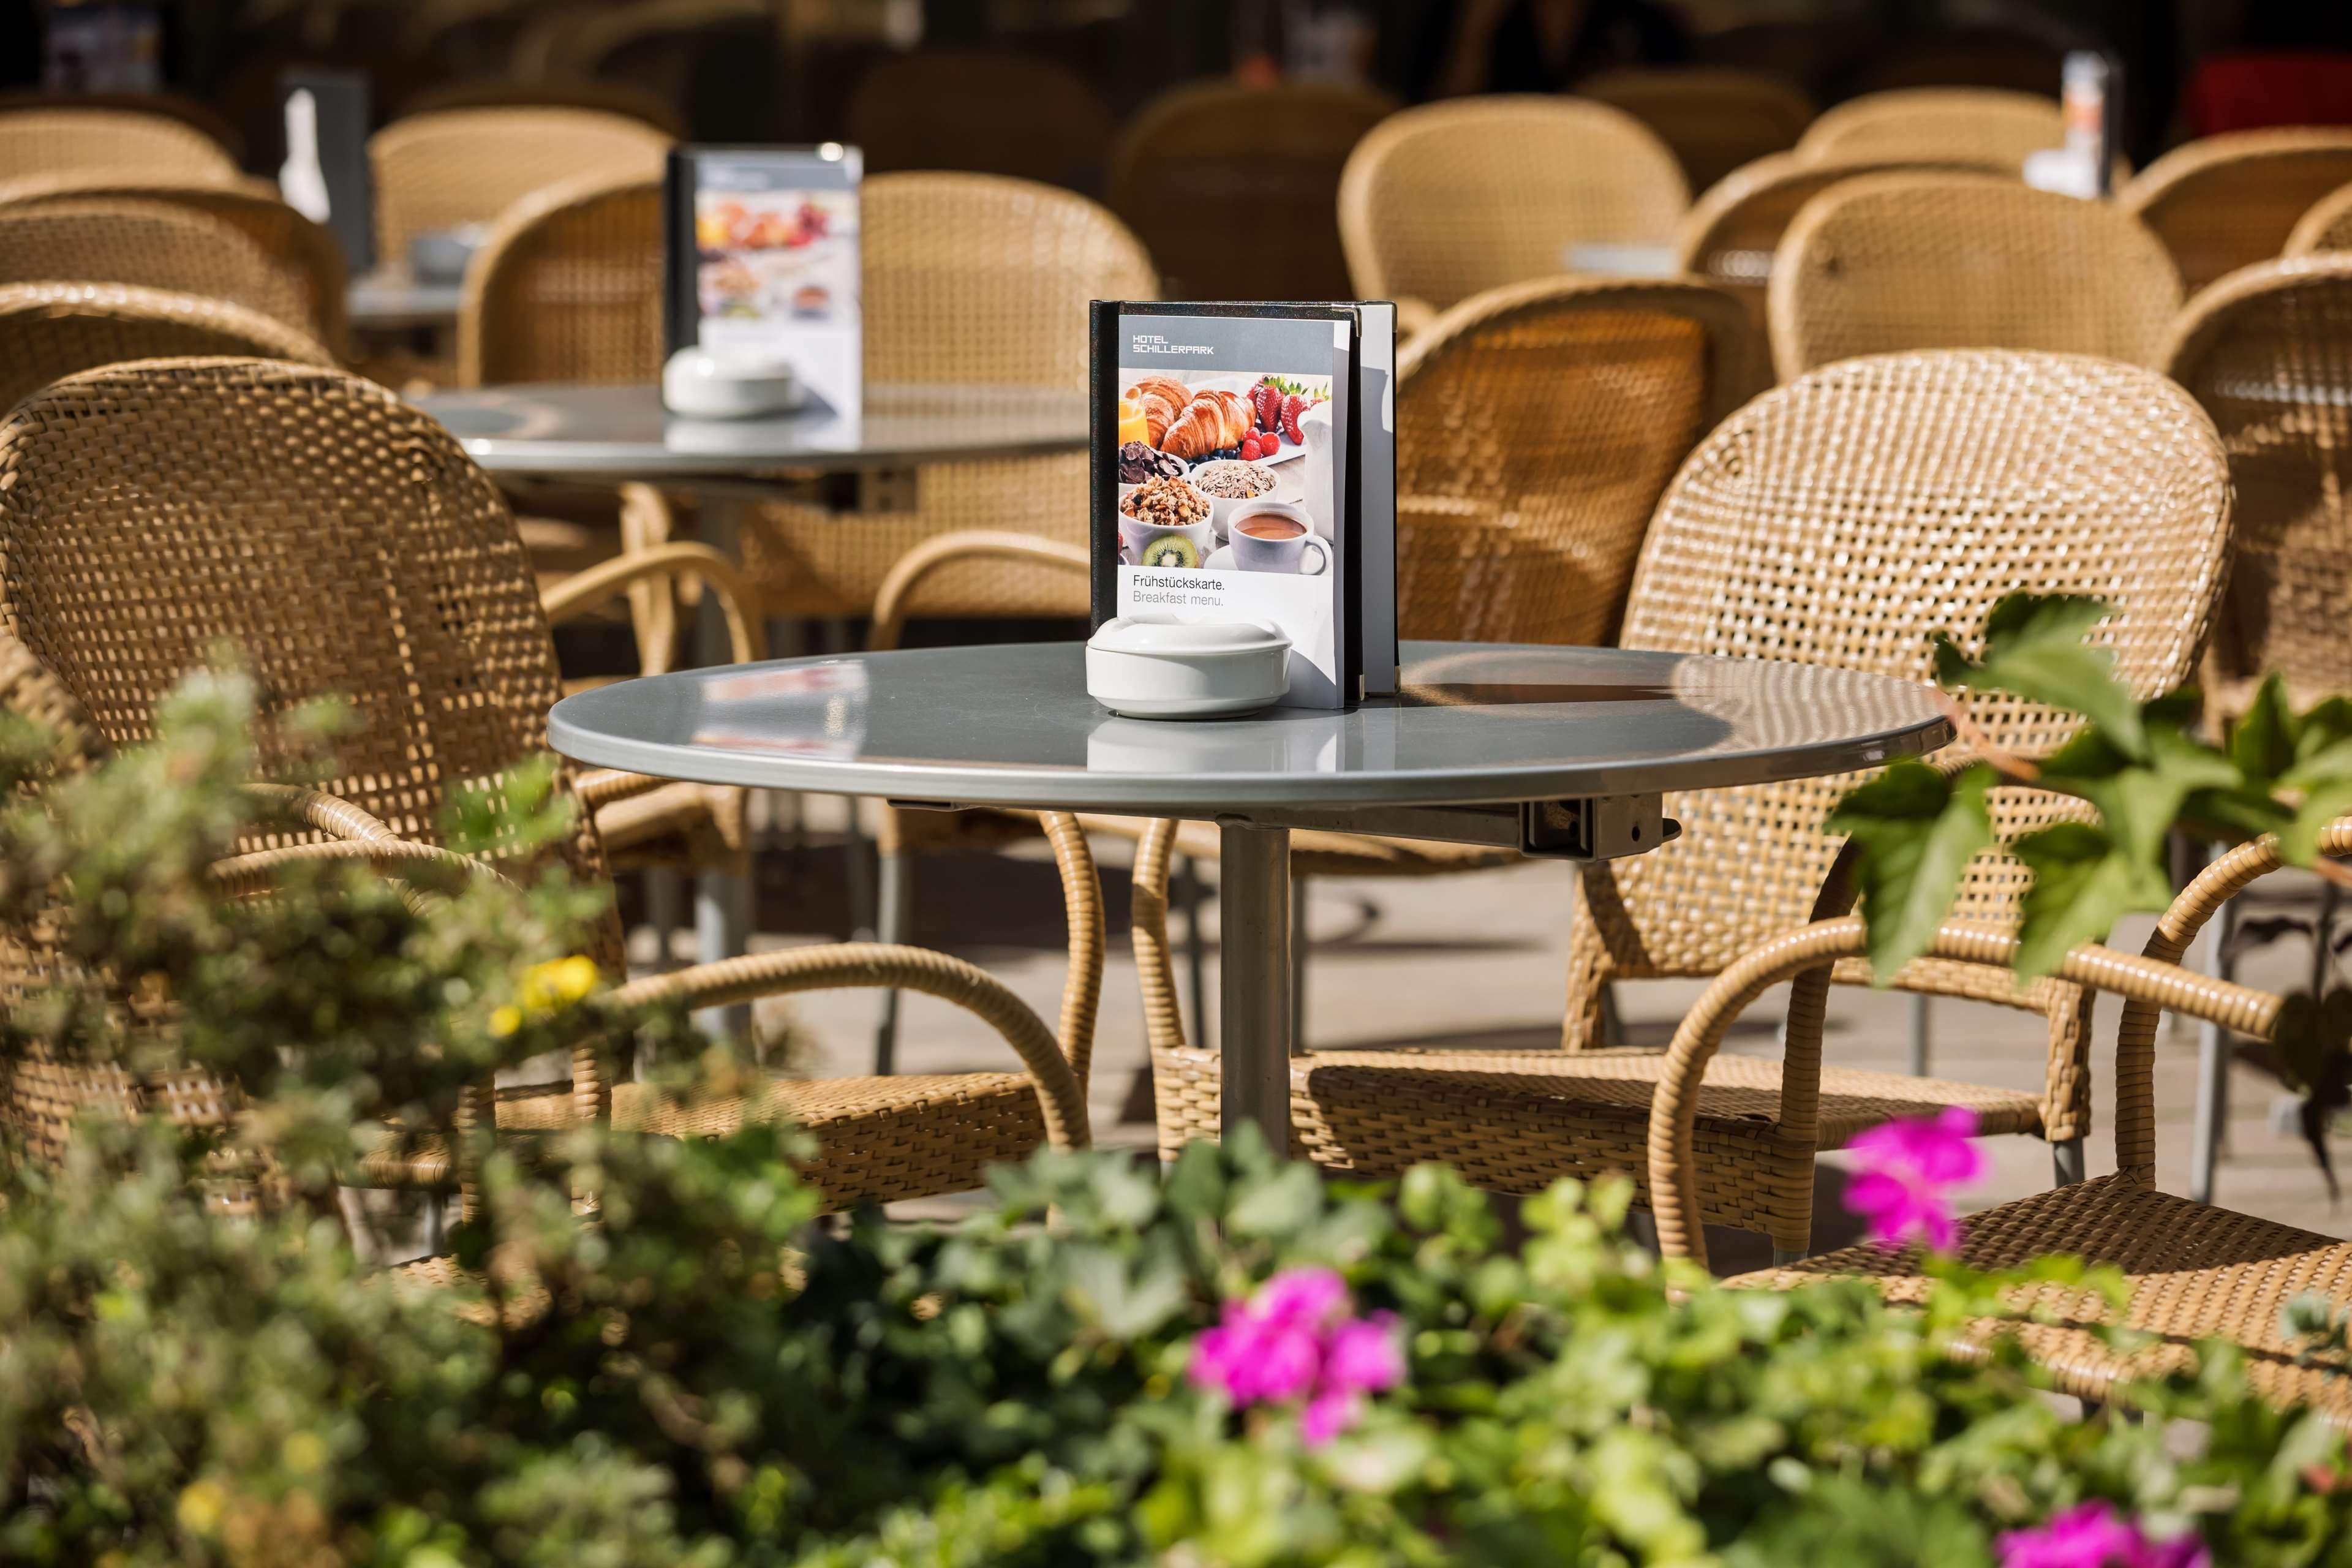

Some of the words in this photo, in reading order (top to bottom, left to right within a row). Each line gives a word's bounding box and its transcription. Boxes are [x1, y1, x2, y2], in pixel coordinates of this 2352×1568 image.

[1133, 335, 1169, 344] HOTEL
[1133, 345, 1214, 355] SCHILLERPARK
[1133, 575, 1225, 590] Frühstückskarte.
[1133, 591, 1186, 605] Breakfast
[1191, 595, 1224, 606] menu.
